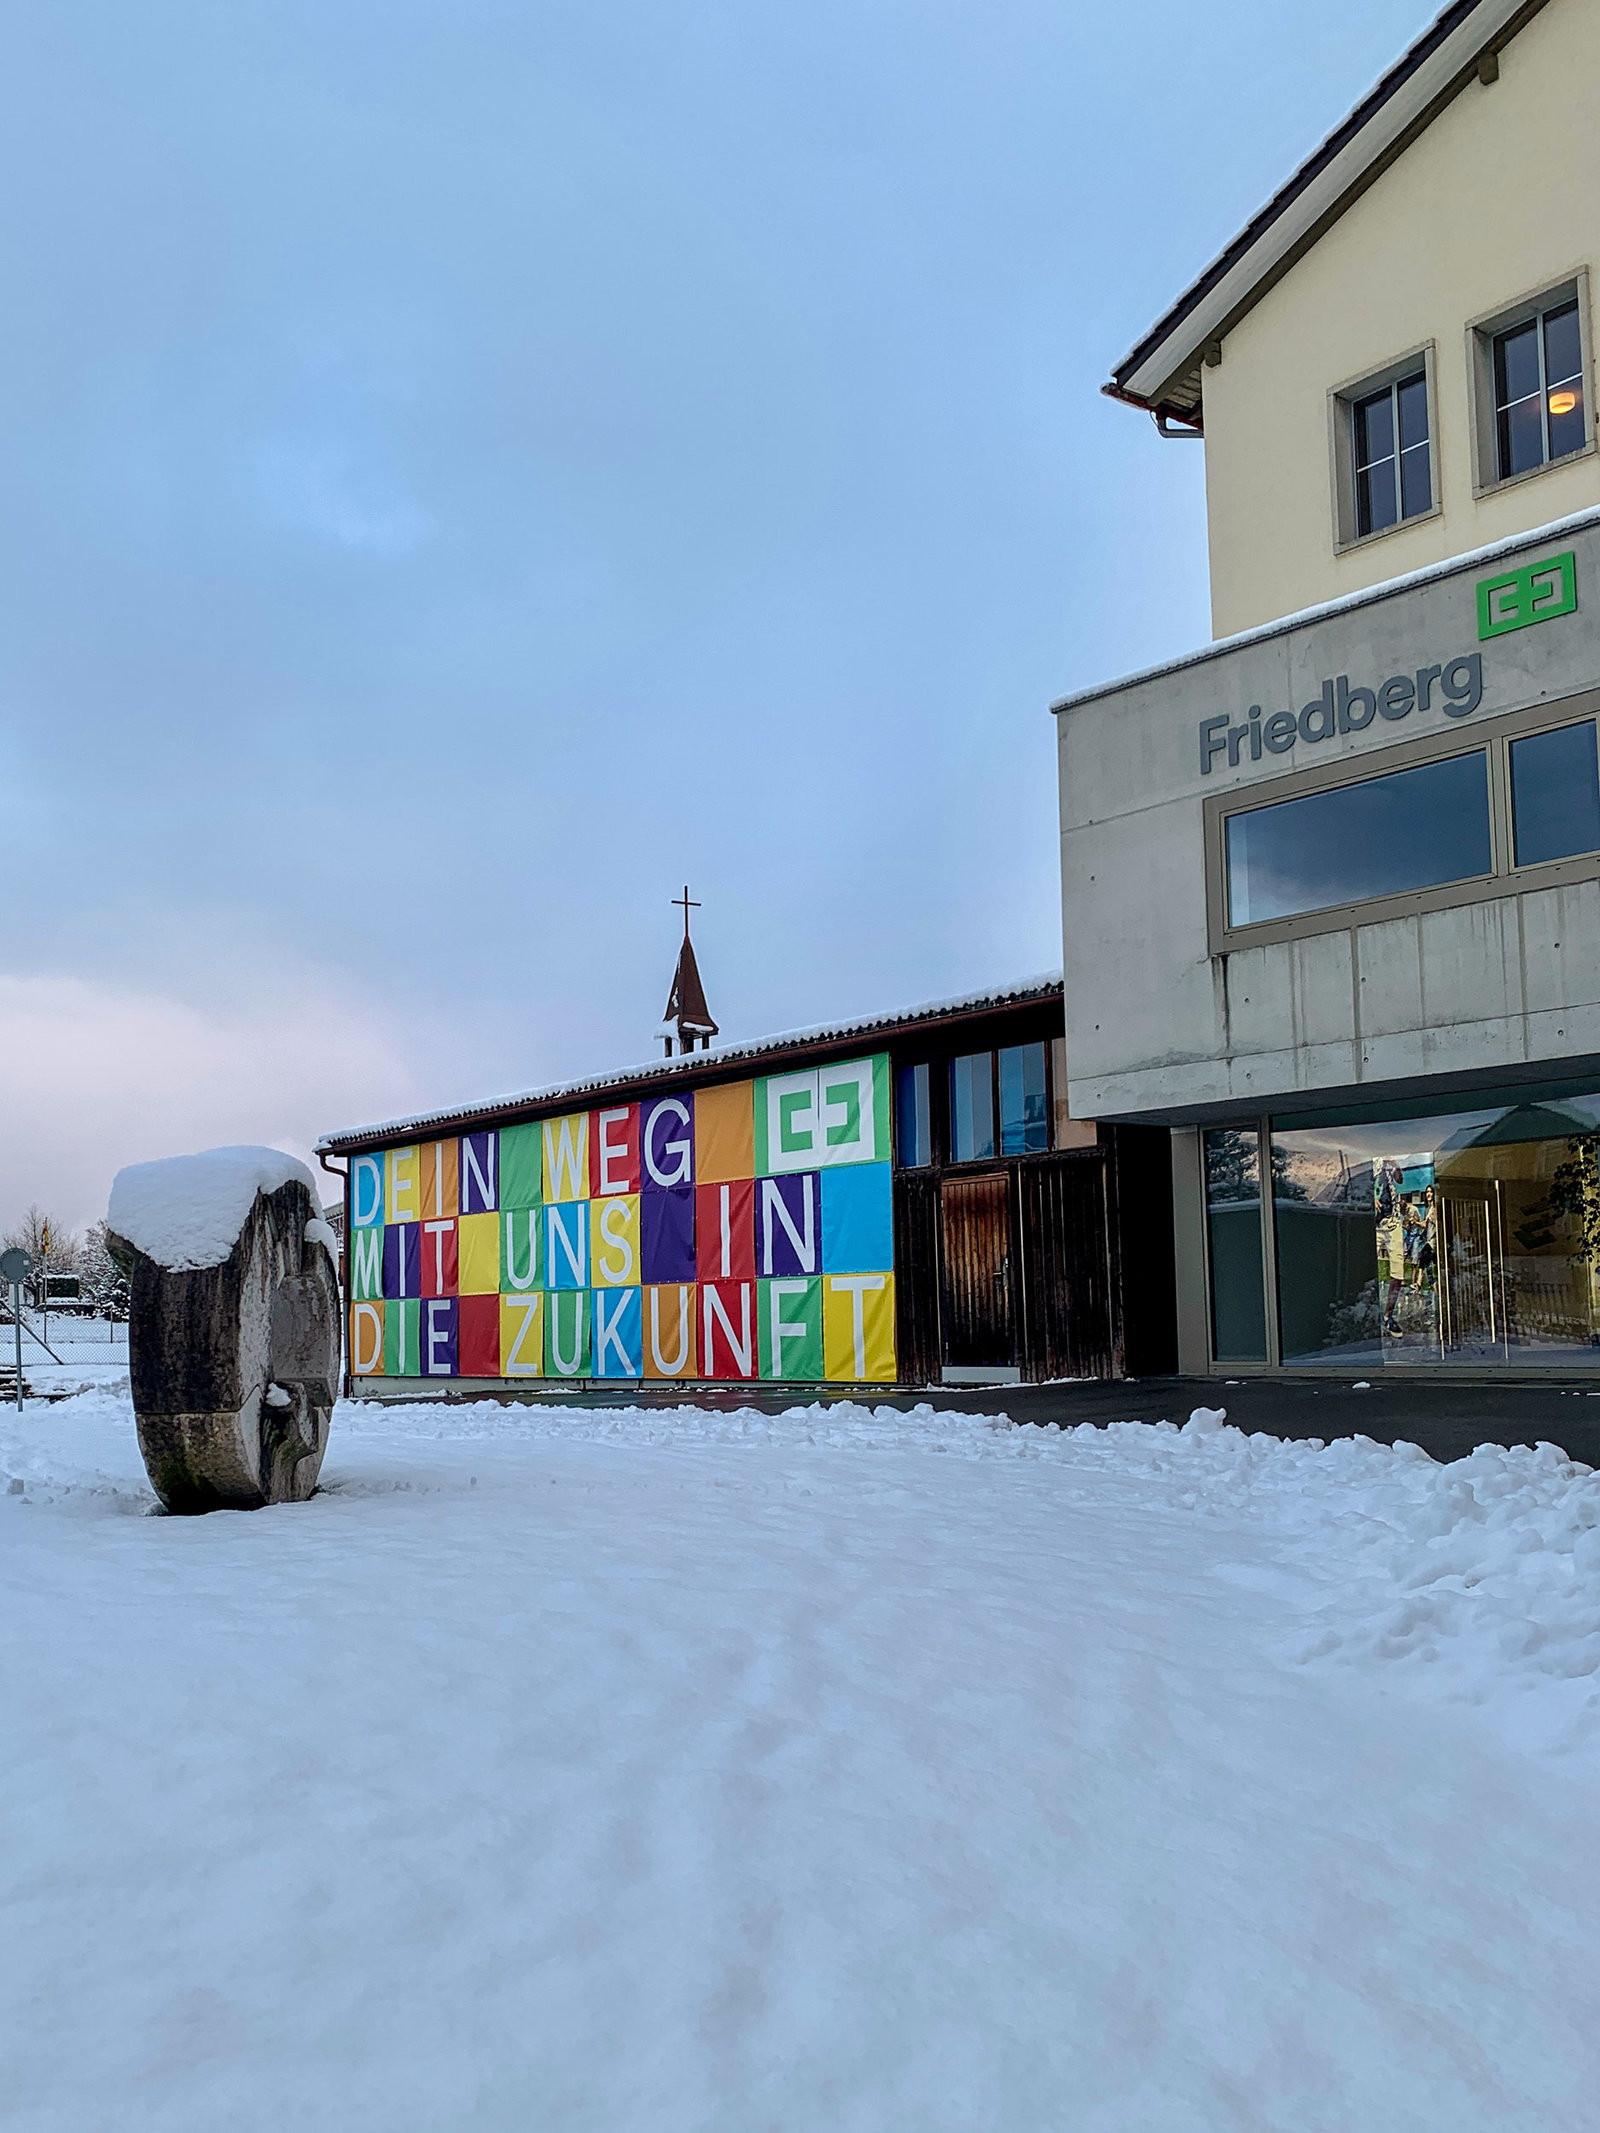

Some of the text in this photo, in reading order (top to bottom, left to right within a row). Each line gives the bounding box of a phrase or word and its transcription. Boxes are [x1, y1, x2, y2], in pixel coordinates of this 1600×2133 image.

[1200, 653, 1483, 774] Friedberg
[354, 1099, 692, 1226] DEIN WEG
[353, 1174, 815, 1299] MIT UNS IN
[354, 1276, 885, 1380] DIE ZUKUNFT
